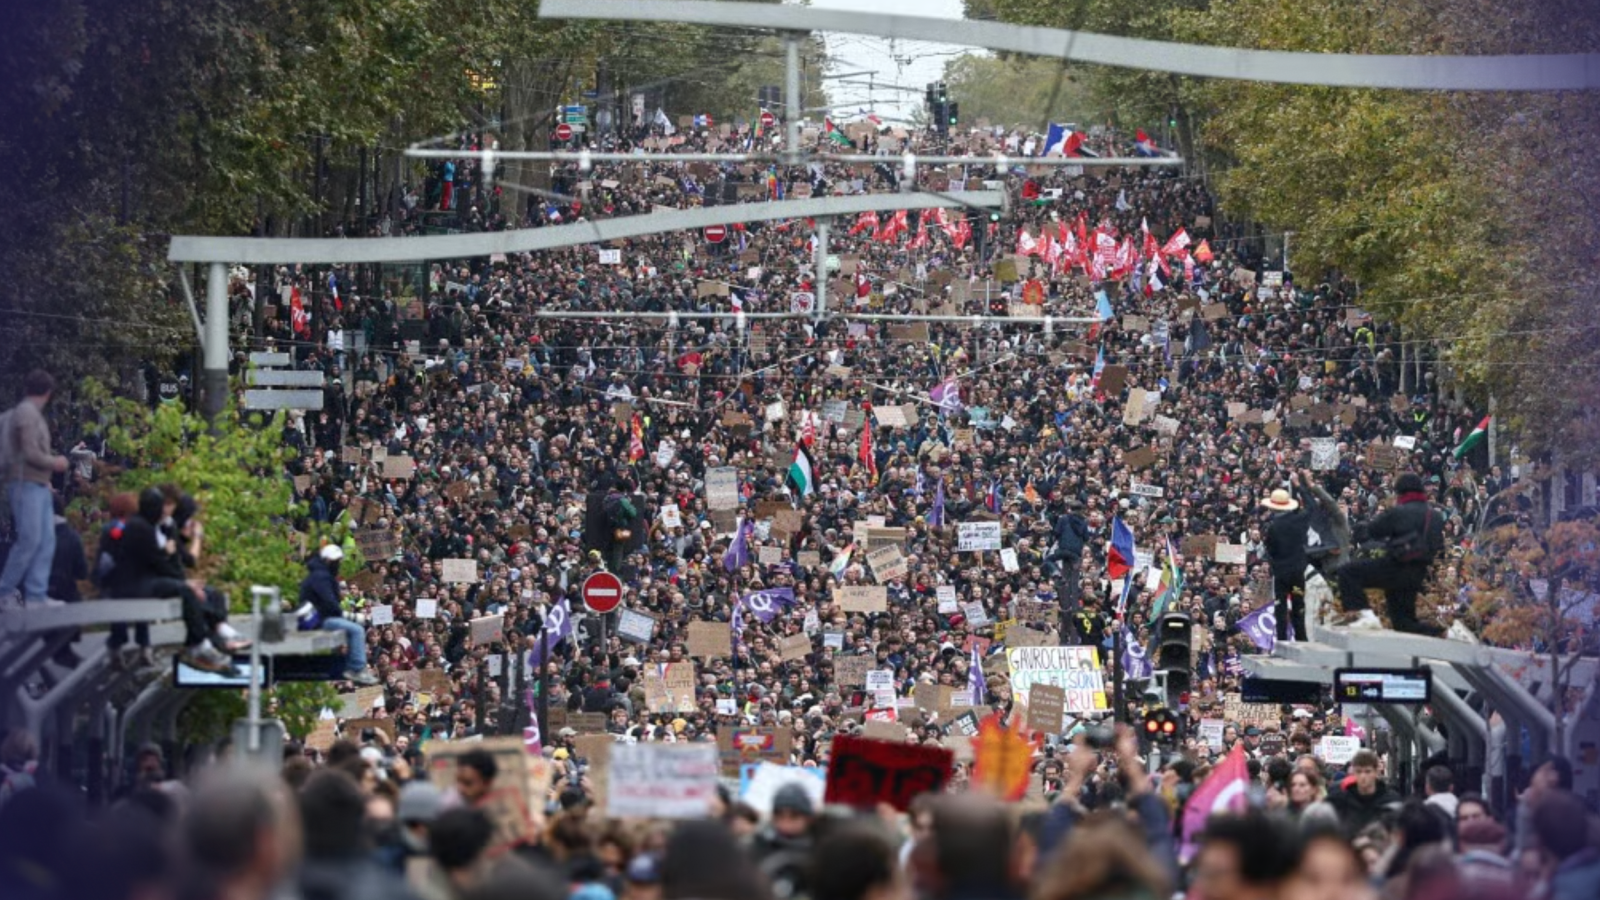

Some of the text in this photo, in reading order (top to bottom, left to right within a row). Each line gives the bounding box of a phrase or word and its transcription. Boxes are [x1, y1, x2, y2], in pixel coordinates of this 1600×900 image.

[1083, 617, 1092, 635] 9
[1068, 690, 1106, 710] RUE
[1346, 686, 1356, 696] 13
